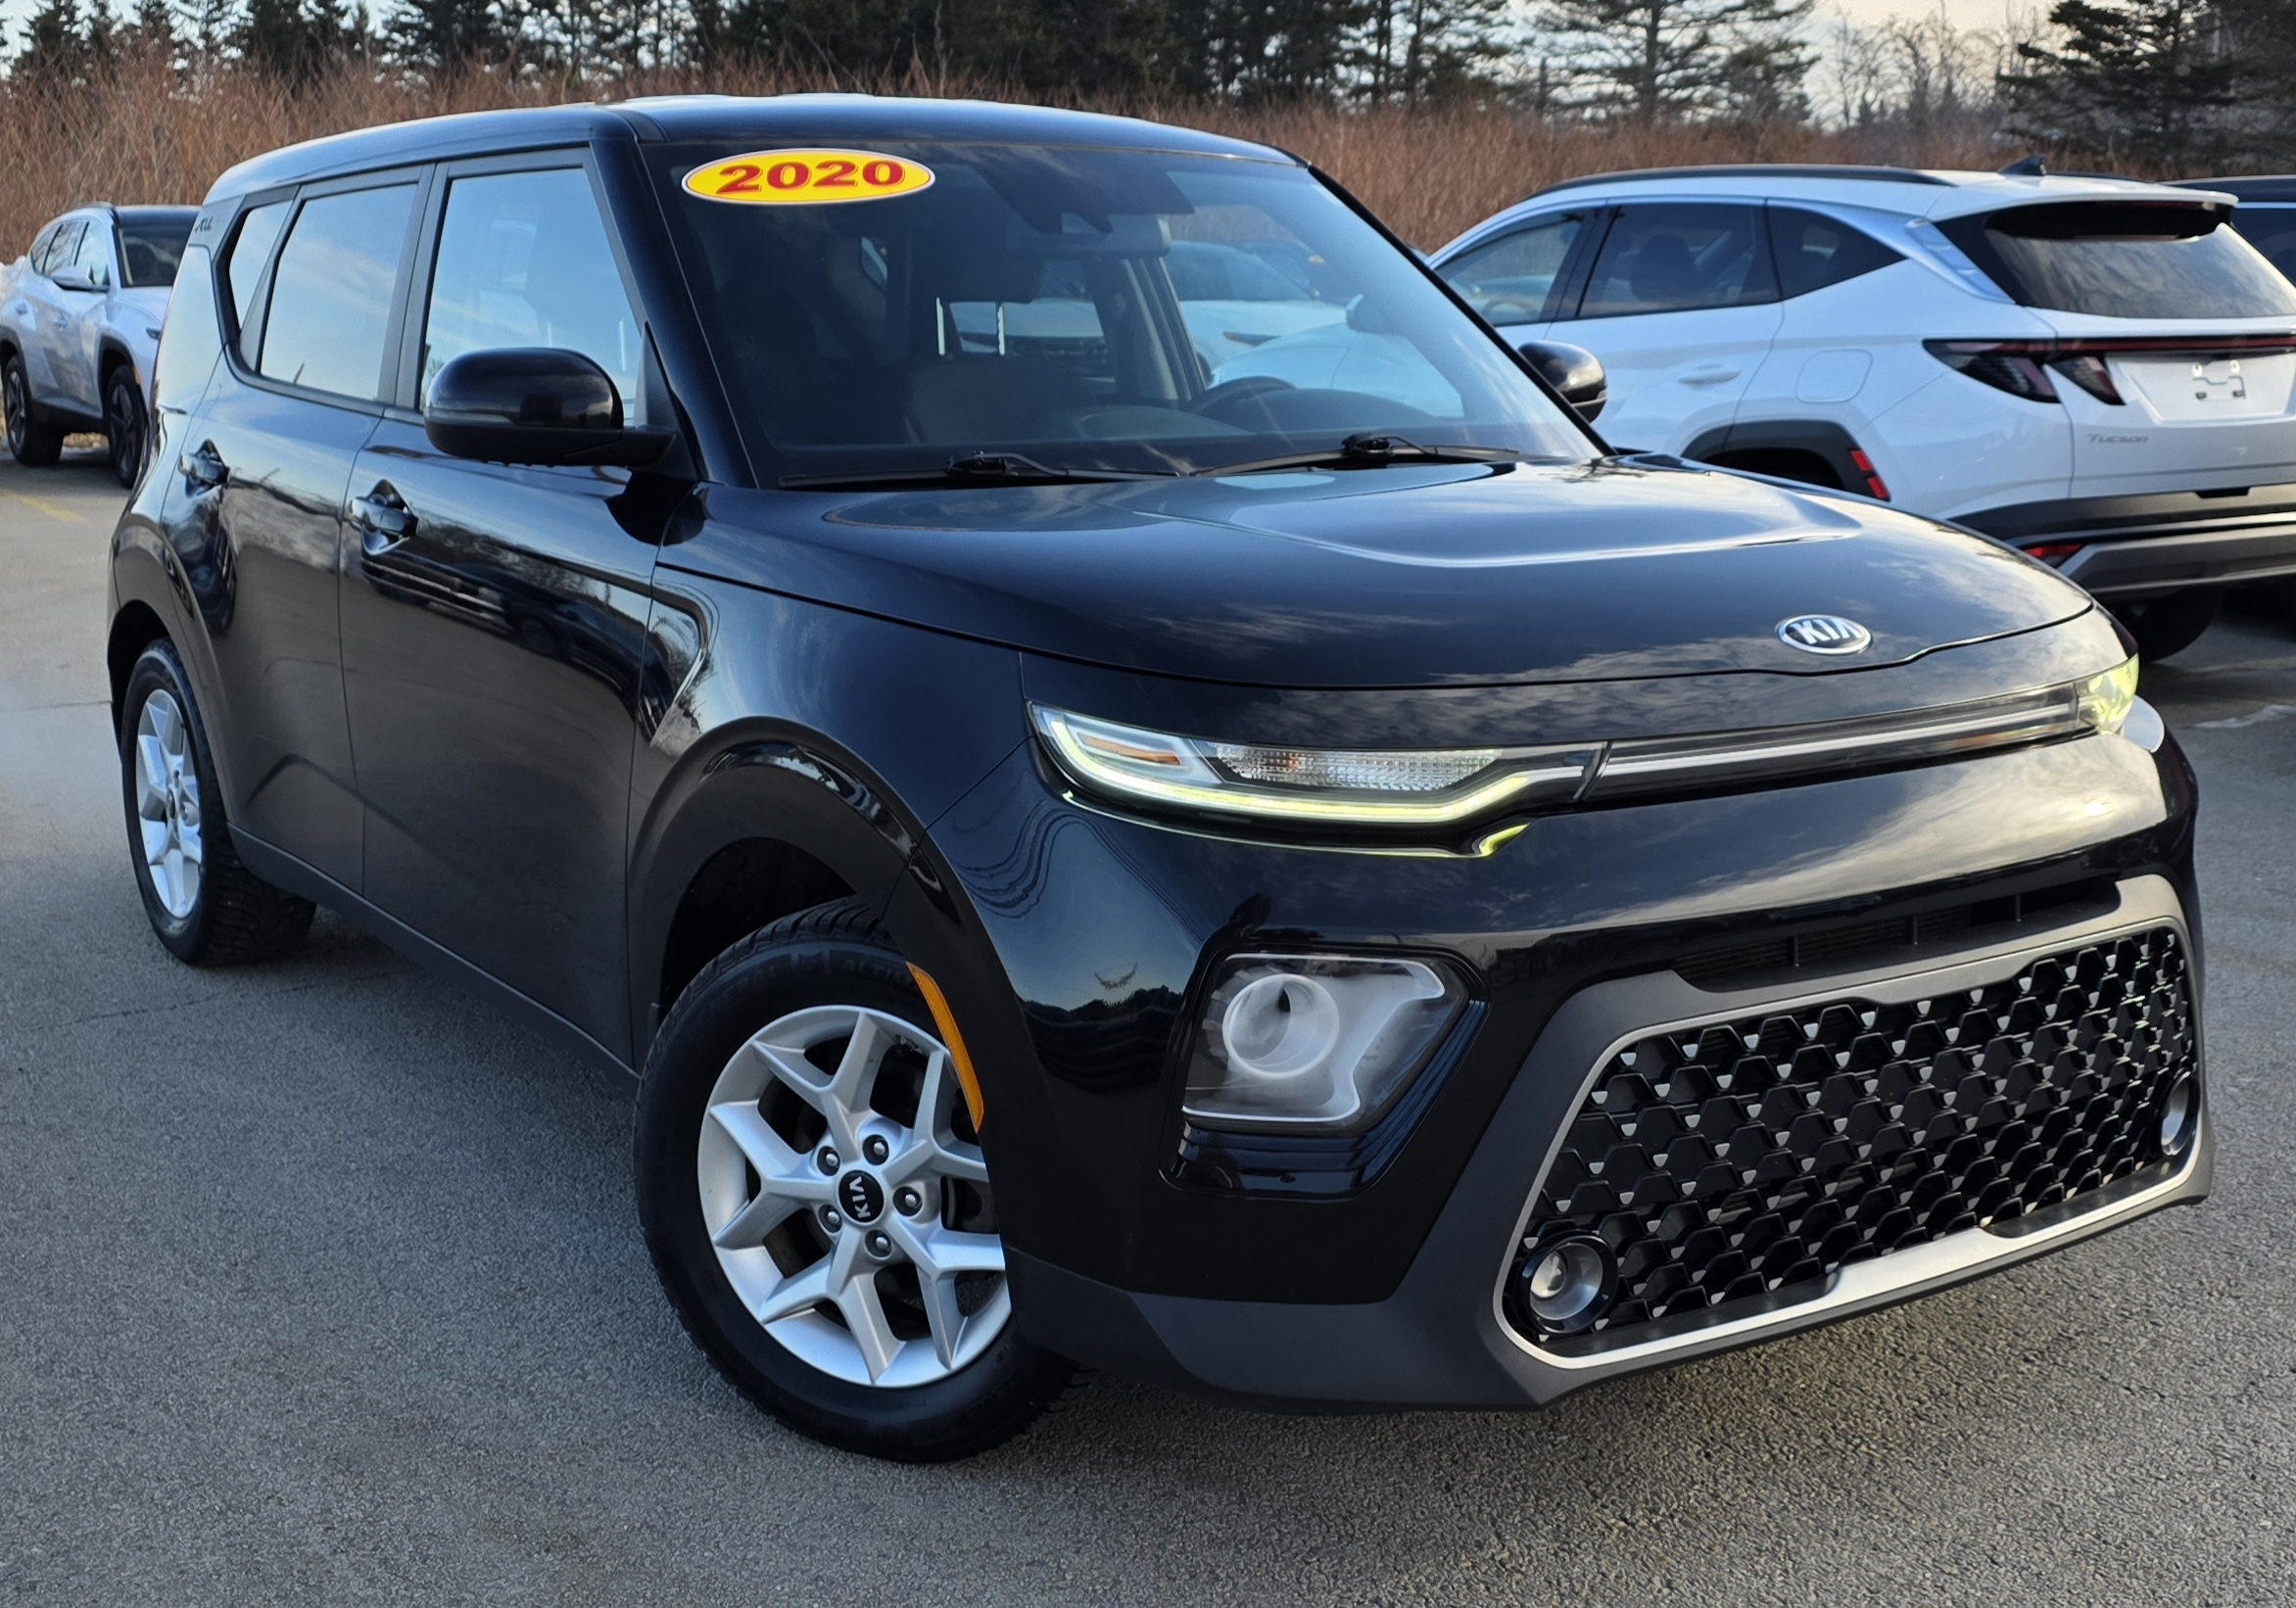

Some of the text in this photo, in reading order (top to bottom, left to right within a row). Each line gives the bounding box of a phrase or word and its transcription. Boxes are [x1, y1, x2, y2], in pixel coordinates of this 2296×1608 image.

[716, 160, 905, 195] 2020
[1790, 618, 1863, 645] KIA
[849, 1175, 872, 1219] KIA
